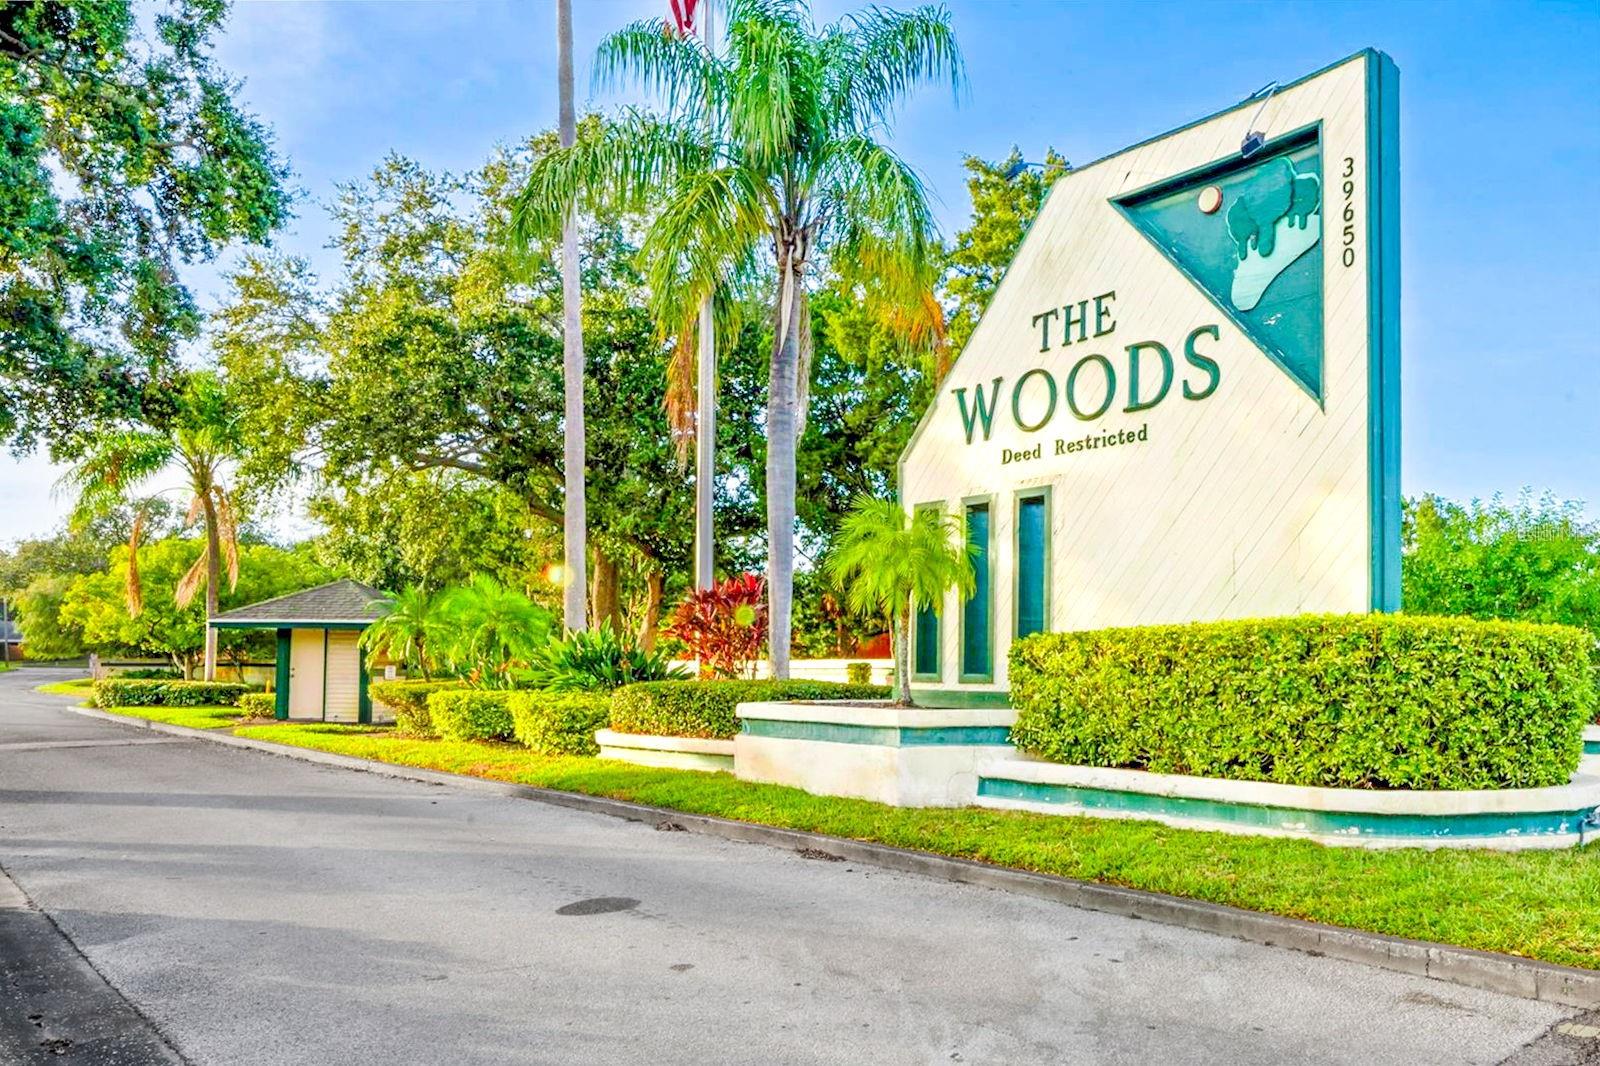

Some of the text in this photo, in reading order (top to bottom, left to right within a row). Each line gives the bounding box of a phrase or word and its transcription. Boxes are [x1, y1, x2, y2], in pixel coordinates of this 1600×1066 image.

[1342, 157, 1355, 268] 39650
[1032, 290, 1118, 353] THE
[951, 324, 1221, 445] WOODS
[1001, 423, 1148, 465] Deed Restricted
